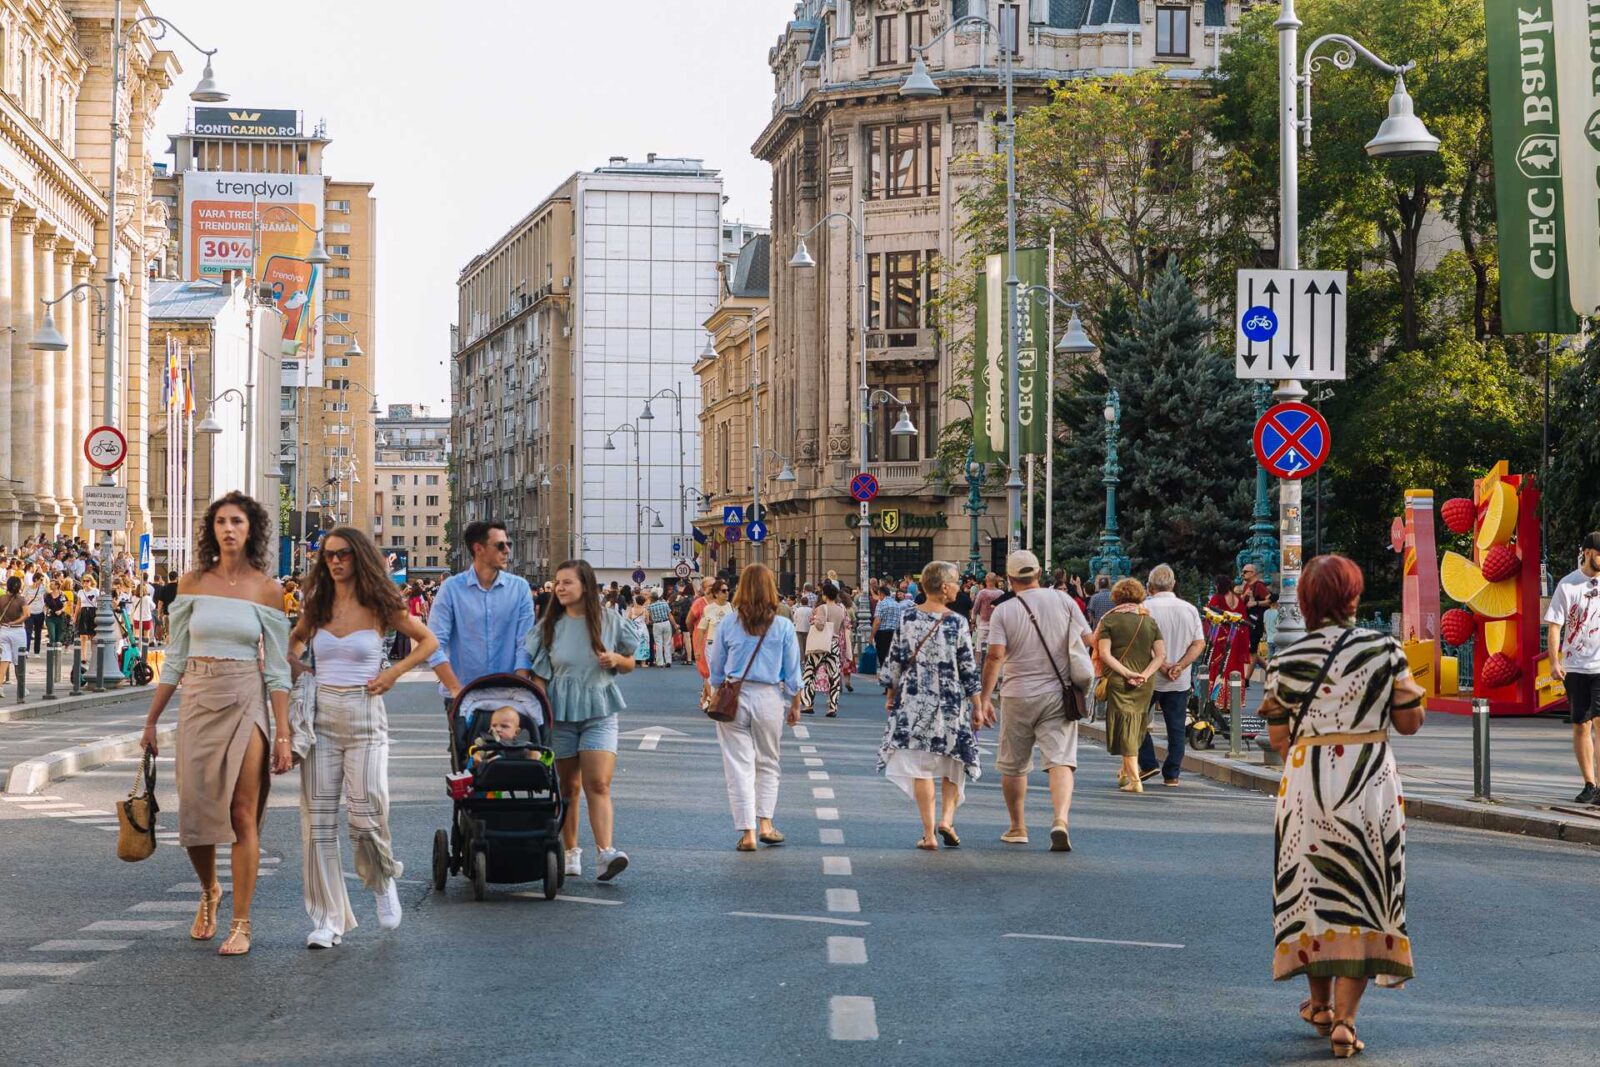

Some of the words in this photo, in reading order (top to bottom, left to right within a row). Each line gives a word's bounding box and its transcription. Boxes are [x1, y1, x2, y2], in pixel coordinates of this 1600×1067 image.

[1517, 7, 1553, 126] Bank
[196, 124, 296, 136] CONTICAZINO.RO
[216, 179, 292, 198] trendyol
[199, 210, 226, 218] VARA
[1527, 187, 1556, 280] CEC
[204, 240, 251, 258] 30%
[272, 270, 304, 282] trendyol
[1018, 376, 1034, 426] CEC
[846, 513, 882, 529] CC
[902, 511, 948, 528] Bank
